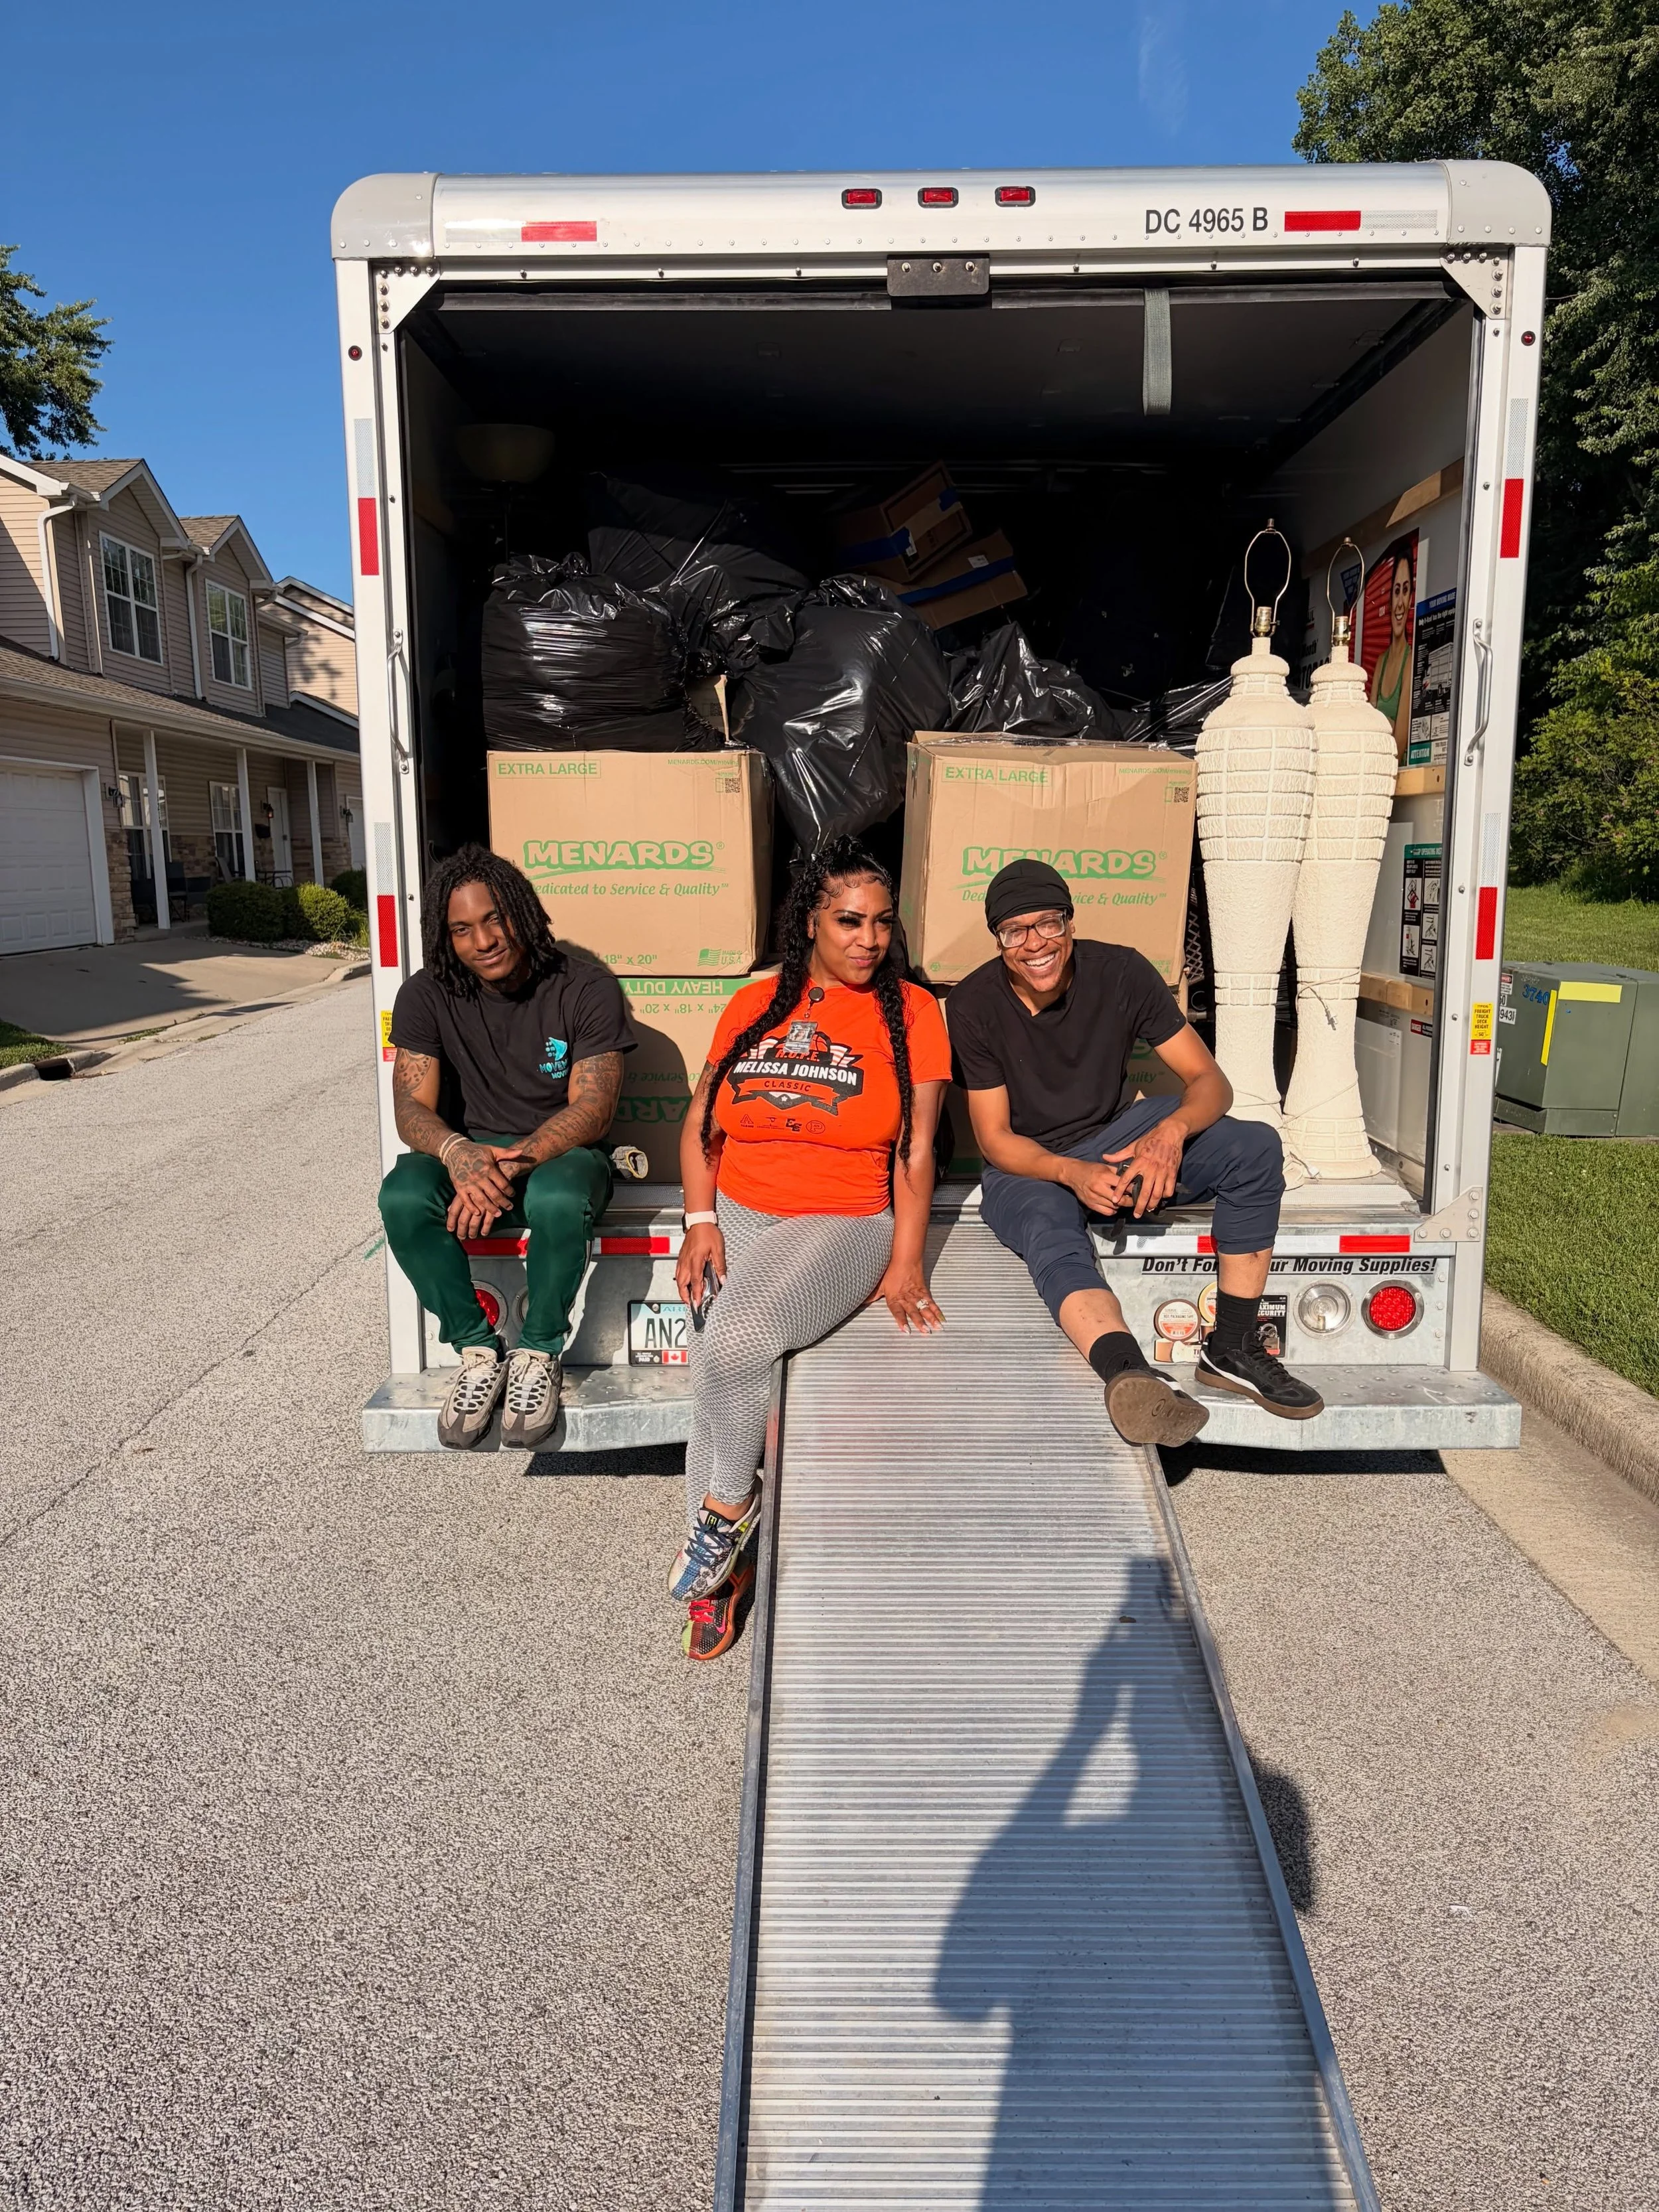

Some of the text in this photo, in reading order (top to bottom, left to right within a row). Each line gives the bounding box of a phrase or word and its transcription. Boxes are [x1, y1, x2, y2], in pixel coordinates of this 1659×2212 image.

[1146, 207, 1268, 234] DC 4965 B
[498, 763, 597, 774] EXTRA LARGE
[945, 766, 1048, 784] EXTRA LARGE
[523, 840, 715, 869] MENARDS
[536, 883, 720, 897] edicated to Service & Quality
[1071, 892, 1158, 906] vice & Quality
[626, 956, 633, 964] x
[637, 954, 658, 964] 20"
[624, 981, 723, 994] HEAVY DUTY
[1522, 984, 1550, 1006] 3740
[640, 1003, 660, 1014] 20"
[674, 1003, 692, 1014] 18"
[733, 1062, 857, 1086] MELISSA JOHNSON
[1128, 1071, 1157, 1084] ality
[764, 1080, 811, 1092] CLASSIC
[1141, 1257, 1438, 1274] Don't For ur Moving Supplies!
[644, 1318, 687, 1348] AN2
